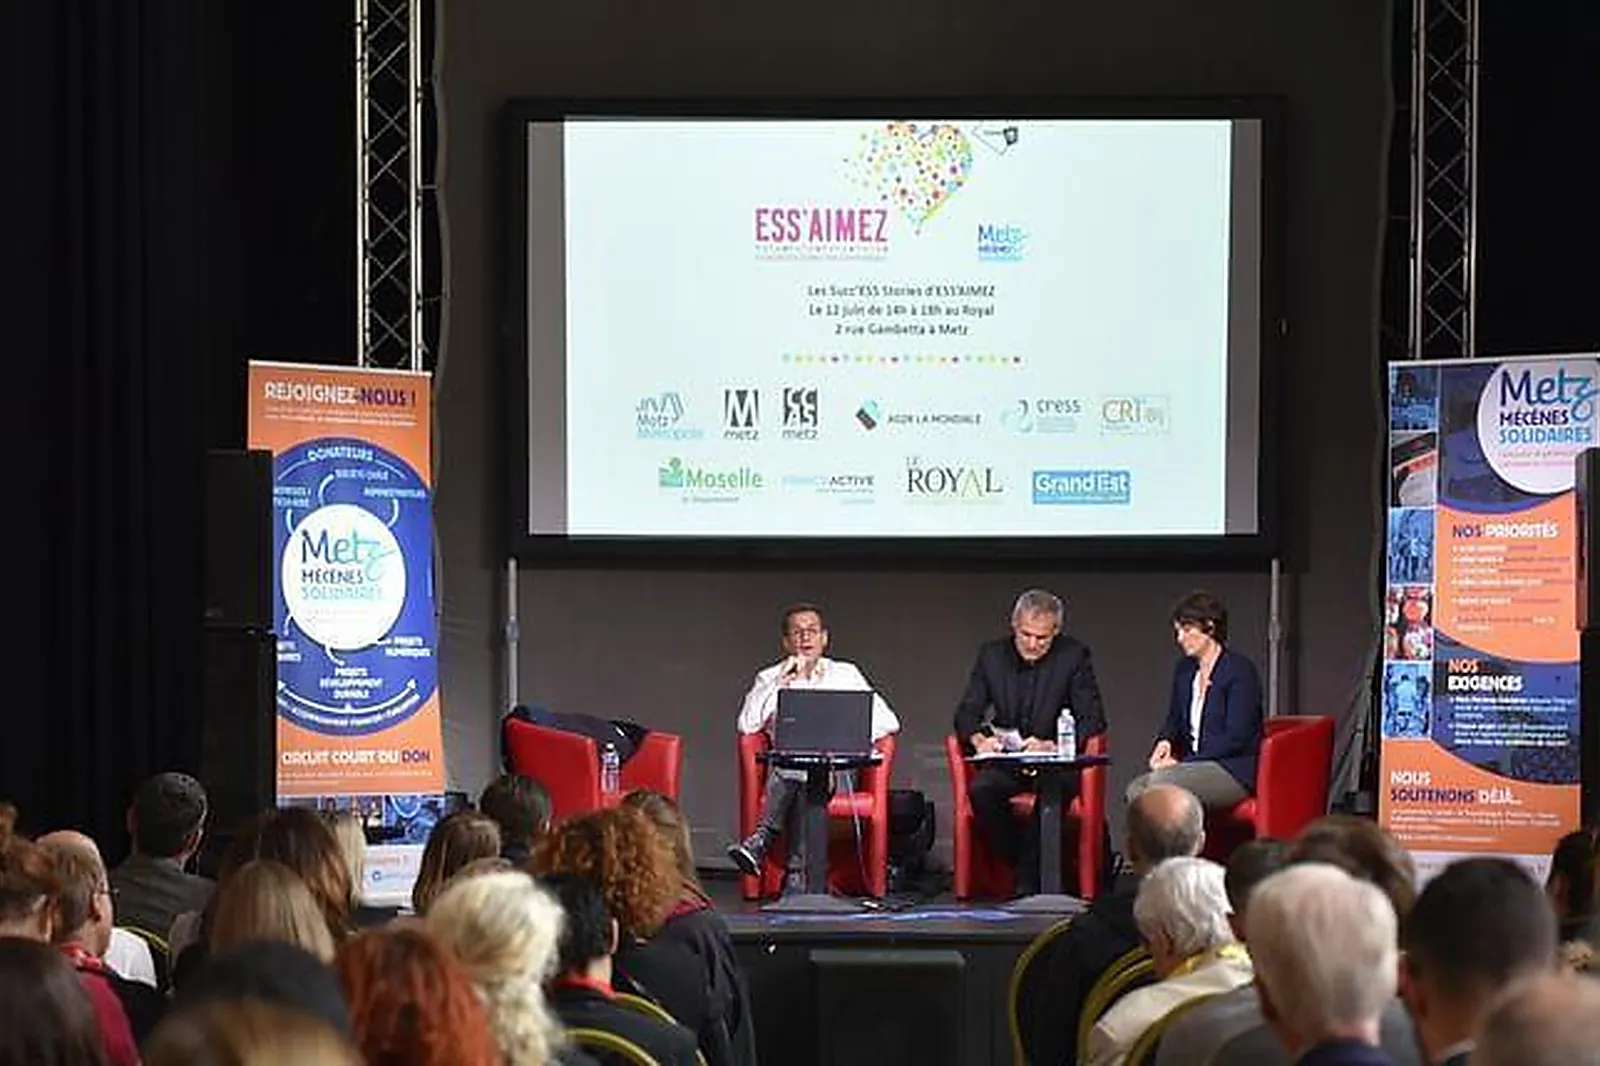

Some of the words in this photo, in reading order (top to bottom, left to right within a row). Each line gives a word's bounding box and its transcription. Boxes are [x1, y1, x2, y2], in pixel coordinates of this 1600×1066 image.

[755, 208, 888, 242] ESS'AIMEZ
[808, 285, 826, 296] Les
[809, 303, 822, 316] Le
[867, 303, 883, 316] de
[945, 307, 960, 316] au
[962, 303, 995, 319] Royal
[834, 322, 842, 335] 2
[845, 325, 865, 335] rue
[938, 322, 968, 335] Metz
[1500, 368, 1600, 422] Metz
[1036, 398, 1082, 413] cress
[1499, 427, 1591, 445] SOLIDAIRES
[686, 466, 763, 489] Moselle
[907, 467, 1004, 497] ROYAL
[1452, 524, 1481, 538] NOS
[300, 527, 397, 582] Metz
[1448, 659, 1479, 673] NOS
[1448, 676, 1523, 692] EXIGENCES
[377, 750, 399, 764] DU
[401, 750, 431, 764] DON
[1390, 771, 1431, 785] NOUS
[1390, 788, 1475, 803] SOUTENONS
